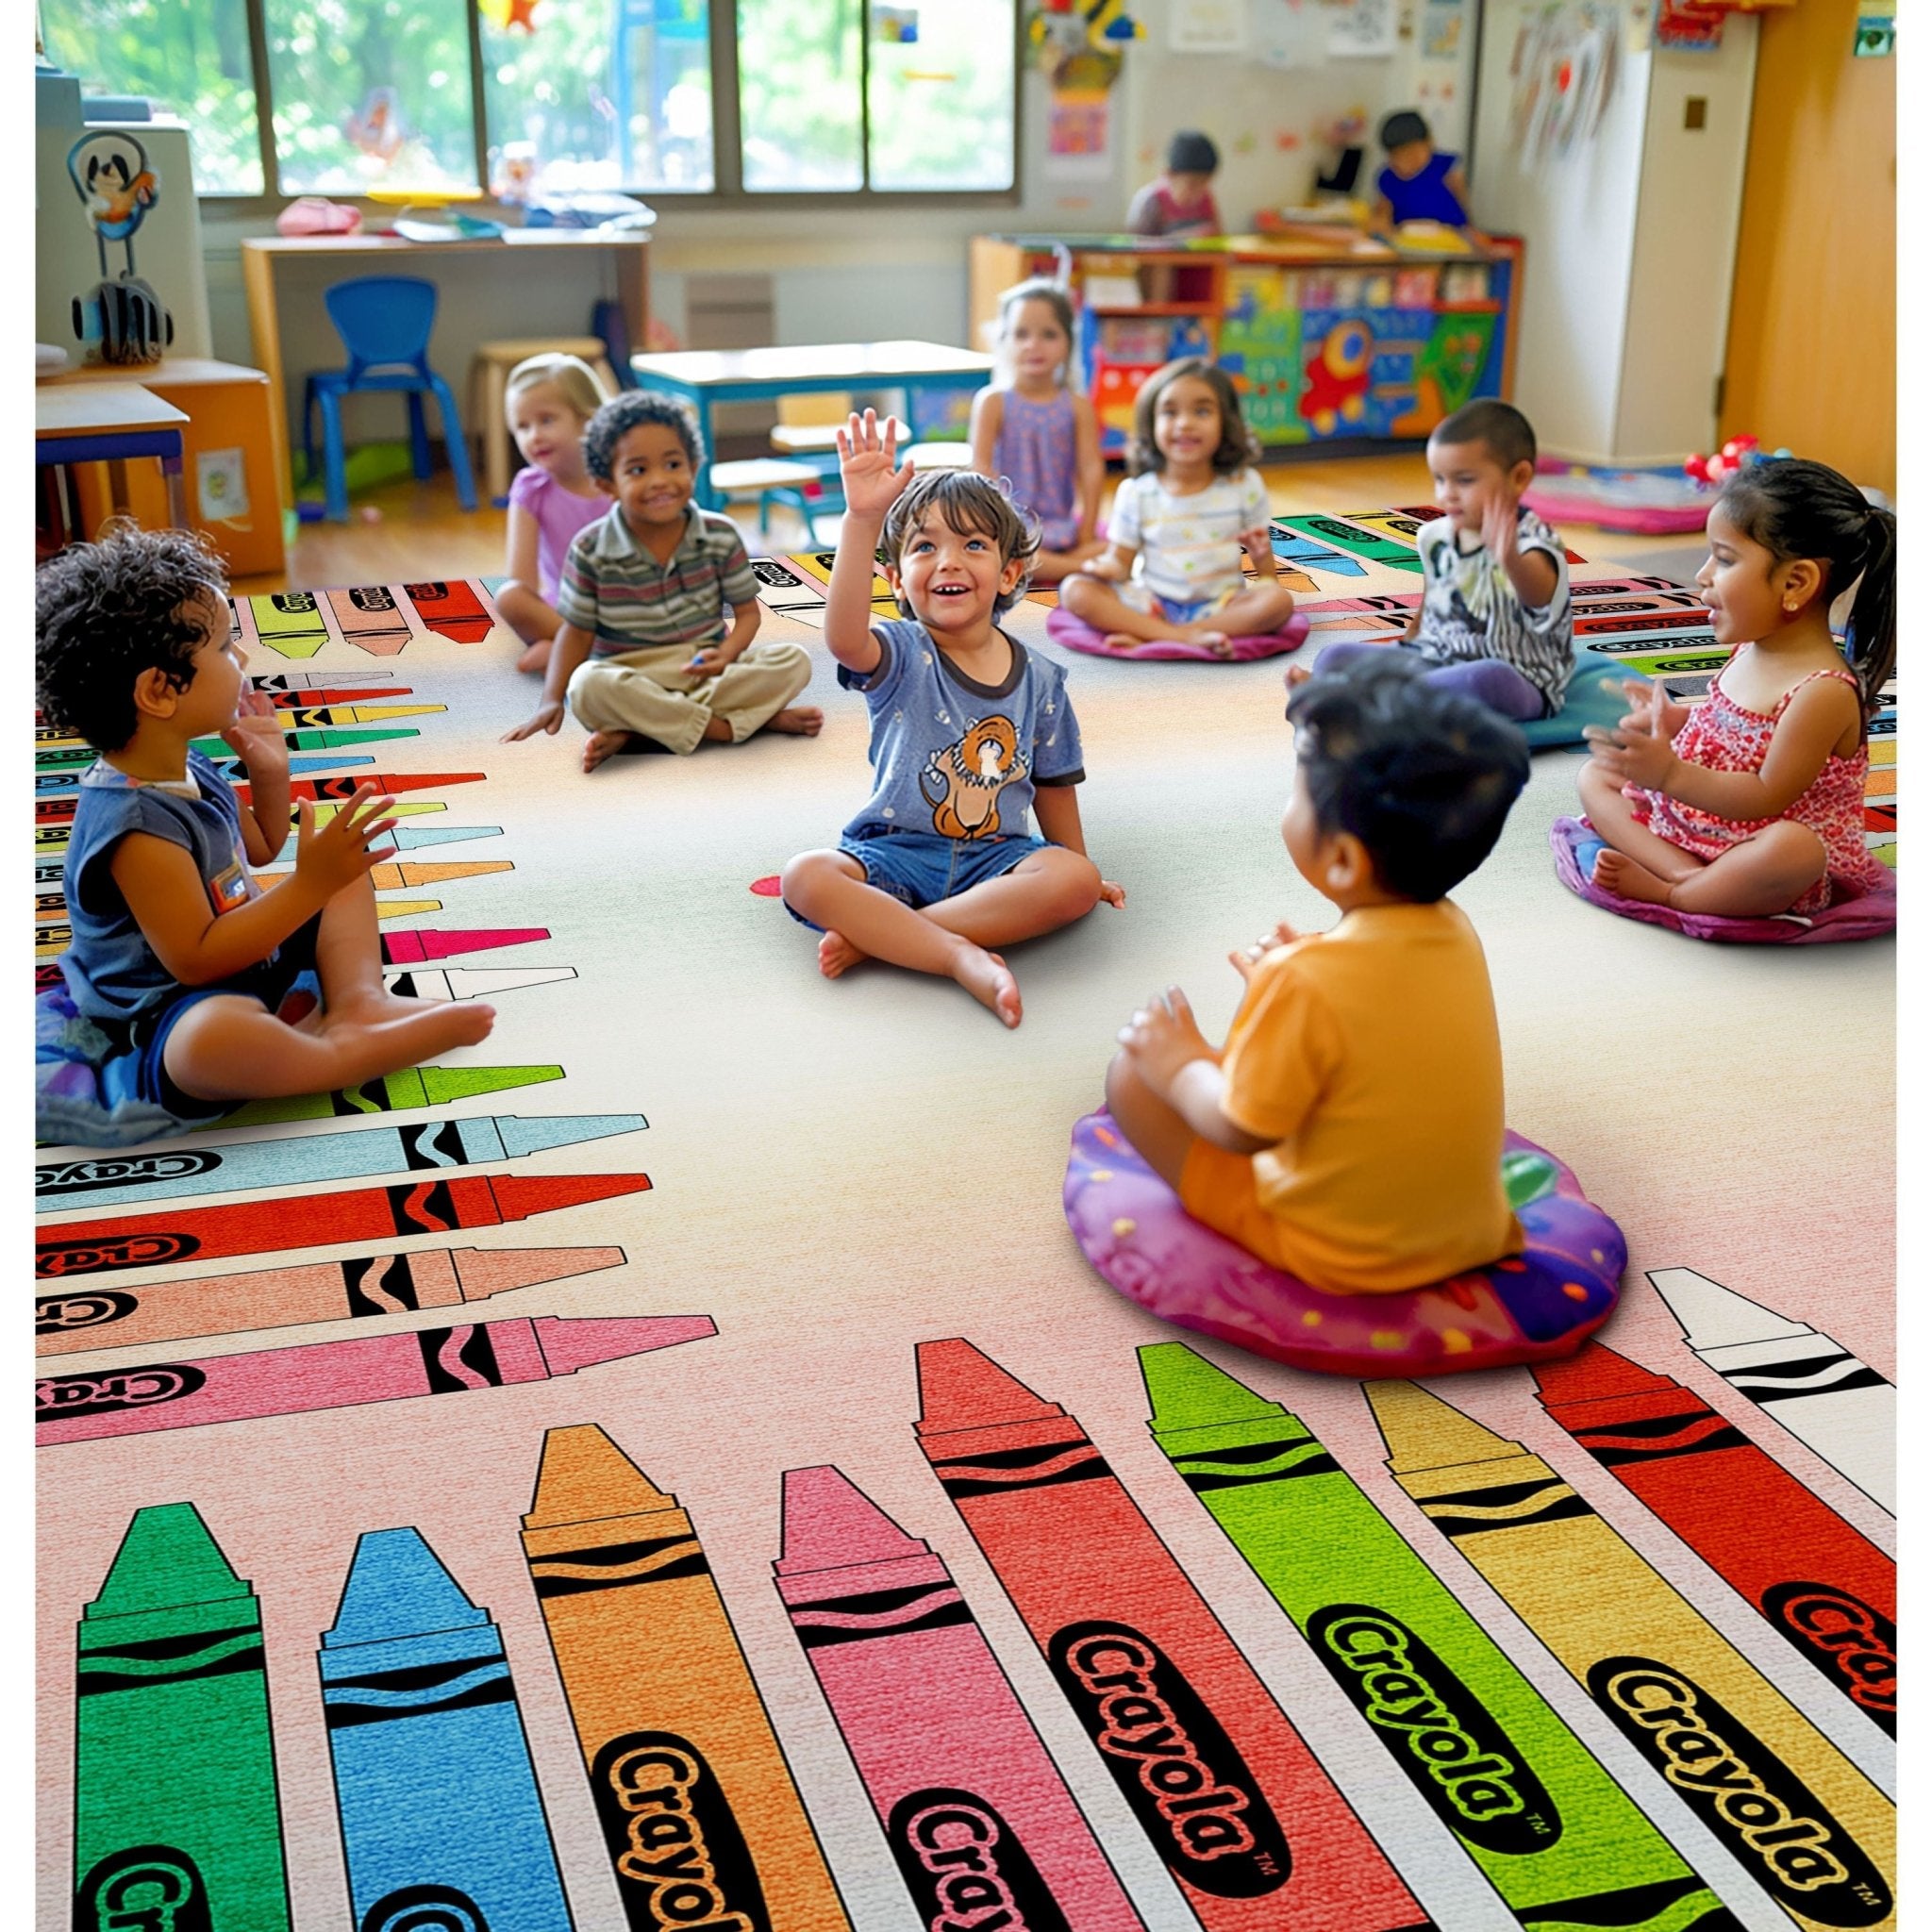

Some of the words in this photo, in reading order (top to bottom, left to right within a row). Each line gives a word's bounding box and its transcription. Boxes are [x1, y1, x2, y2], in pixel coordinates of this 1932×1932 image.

[1066, 1634, 1256, 1861] Crayola
[1324, 1617, 1525, 1822] Crayola
[1607, 1670, 1849, 1891] Crayola
